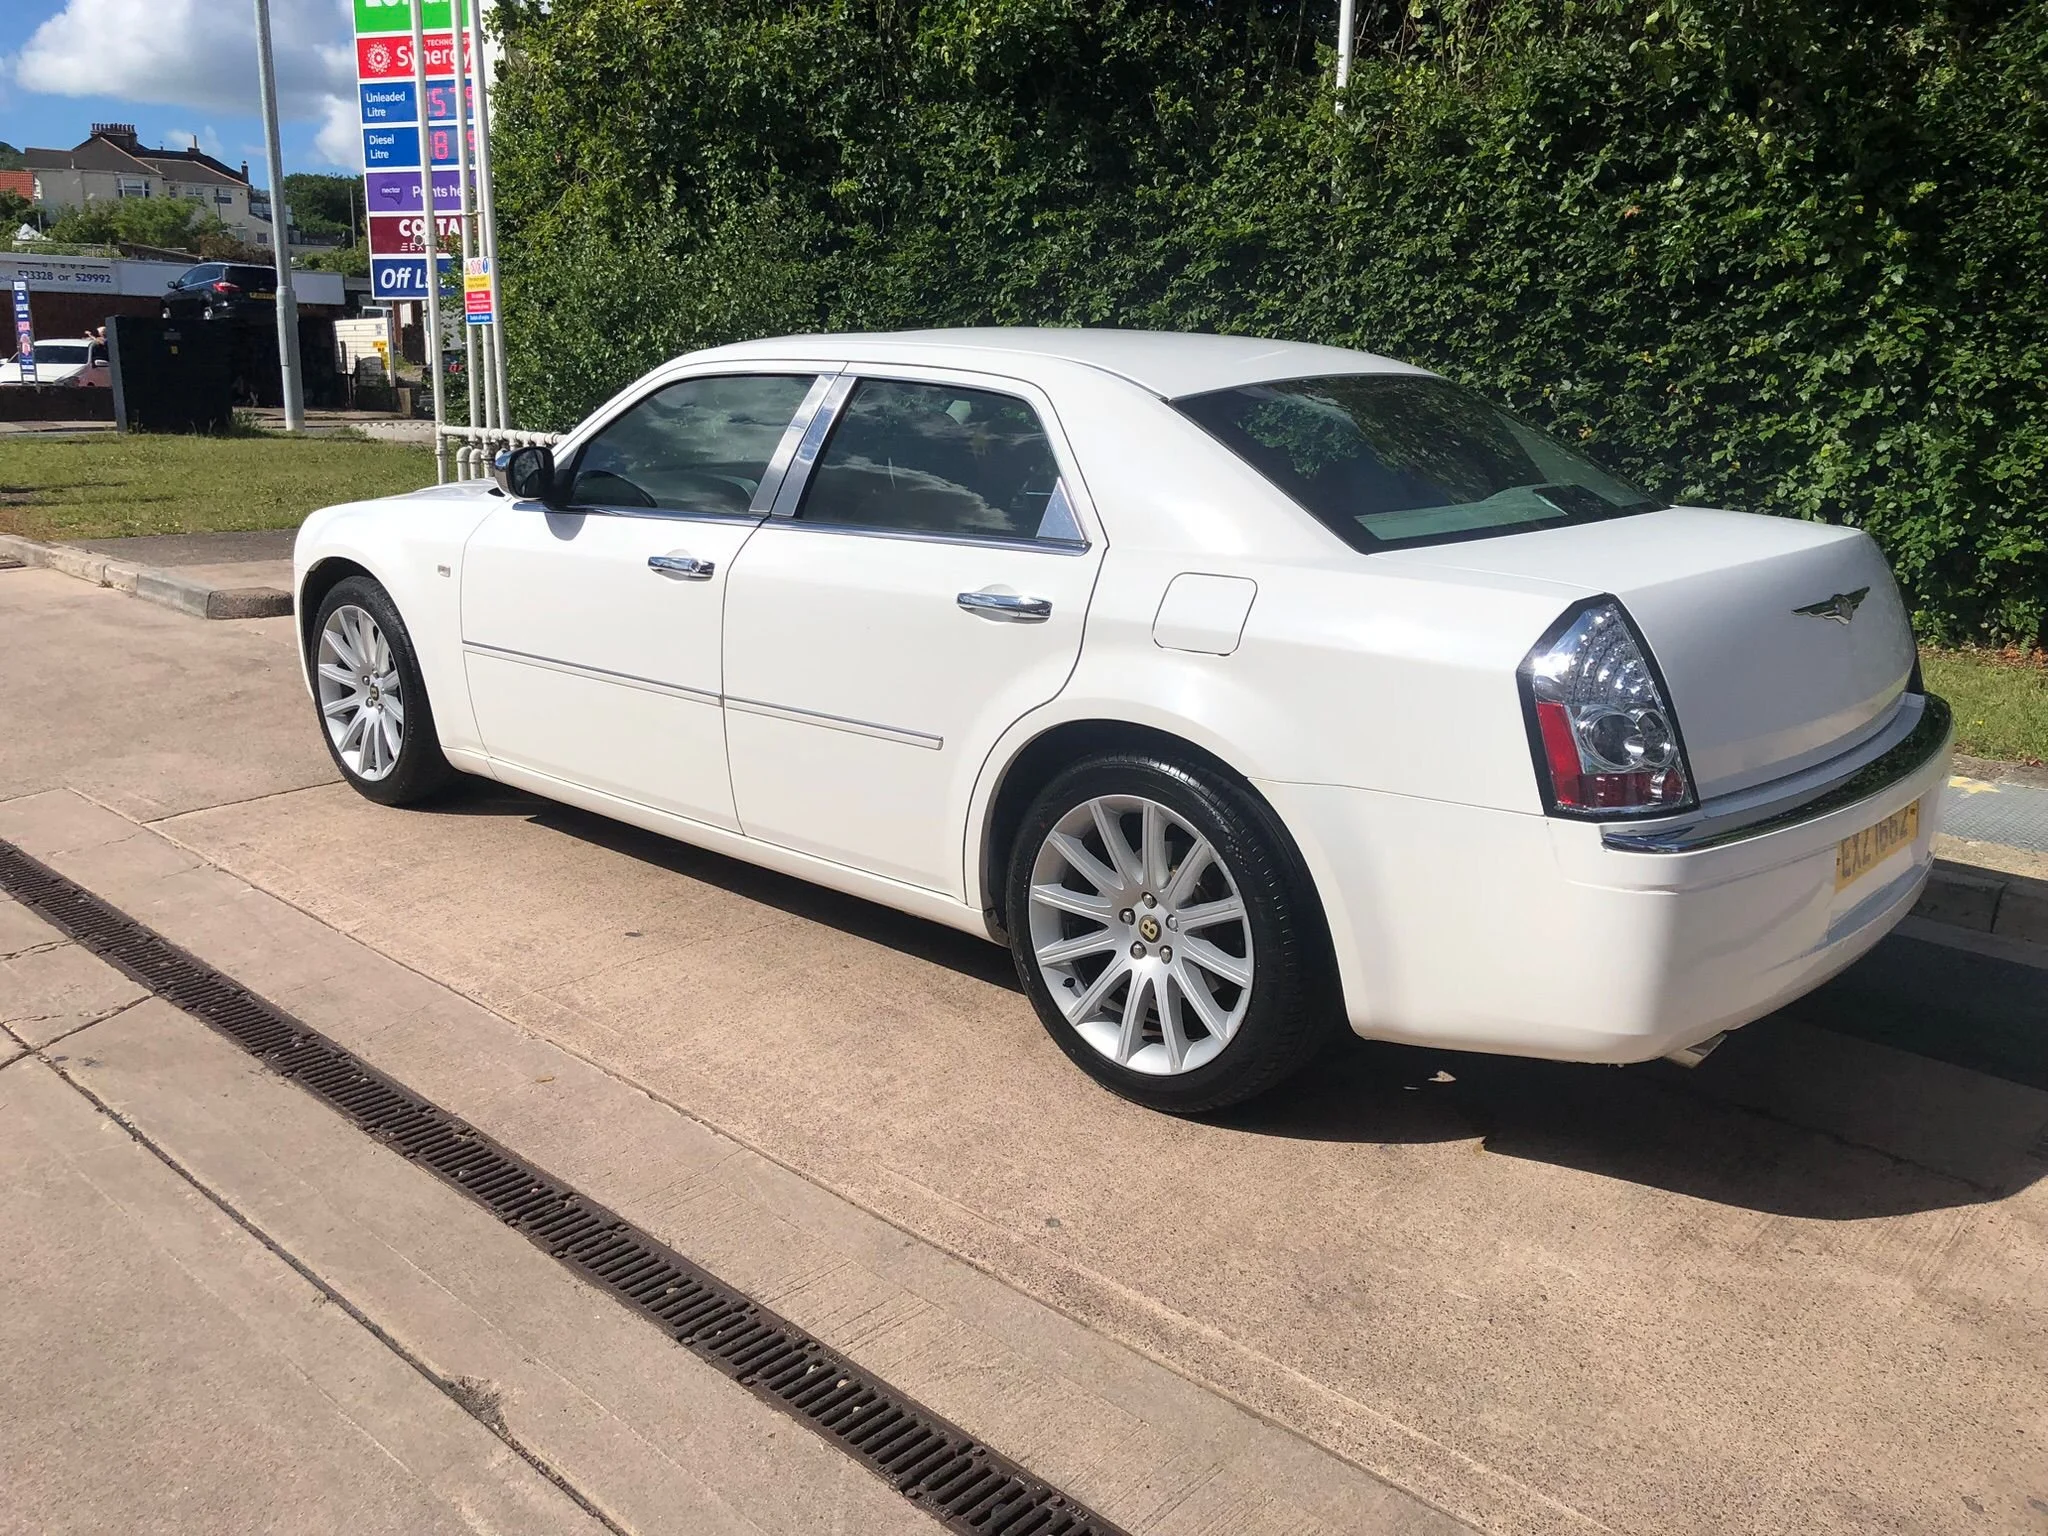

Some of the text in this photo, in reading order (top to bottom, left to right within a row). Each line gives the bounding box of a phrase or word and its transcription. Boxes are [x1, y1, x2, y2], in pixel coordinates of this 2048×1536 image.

[366, 91, 405, 103] Unleaded
[367, 107, 386, 118] Litre
[369, 134, 395, 145] Diesel
[370, 149, 389, 159] Litre
[399, 218, 461, 237] COTA
[75, 273, 111, 284] 529992
[380, 267, 412, 289] Off
